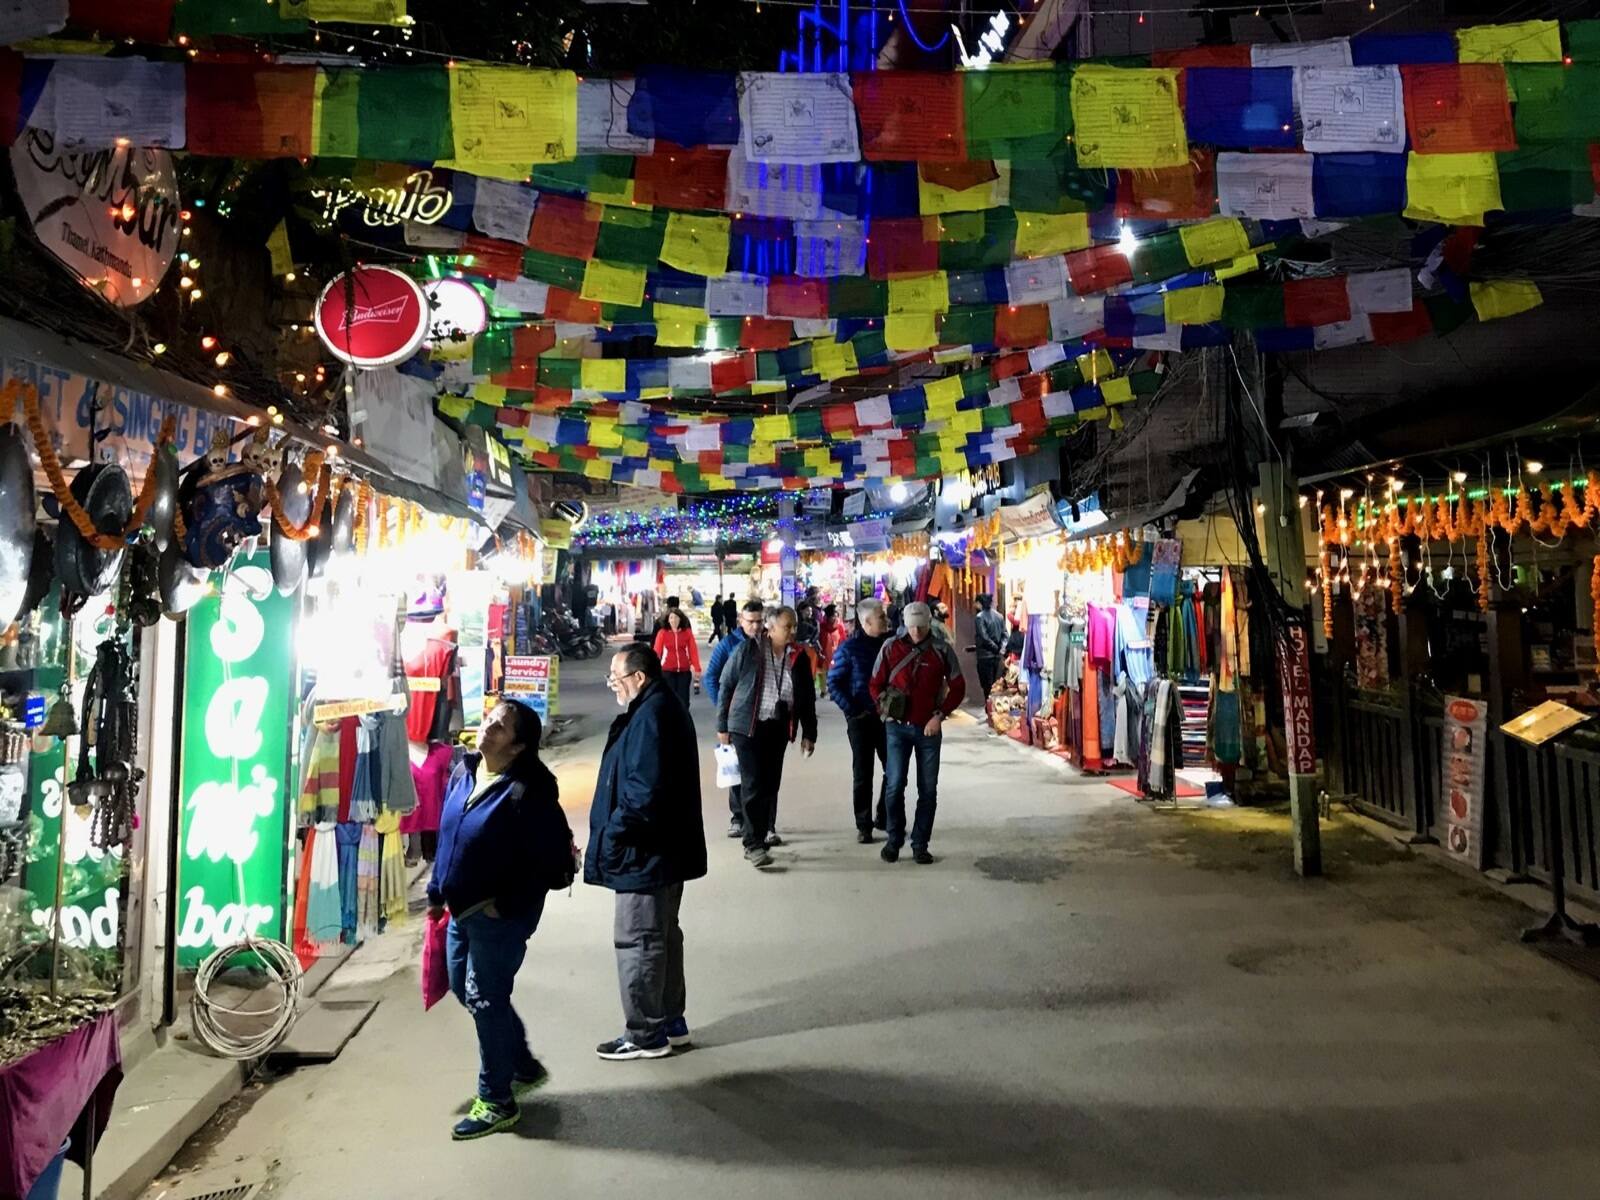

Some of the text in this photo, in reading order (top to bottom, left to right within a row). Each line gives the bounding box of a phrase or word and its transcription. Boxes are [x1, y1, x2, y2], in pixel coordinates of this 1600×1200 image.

[342, 305, 403, 322] Budweiser
[505, 656, 548, 669] Laundry
[505, 666, 546, 677] Service
[1293, 695, 1313, 773] MANDAP
[177, 886, 274, 949] bar
